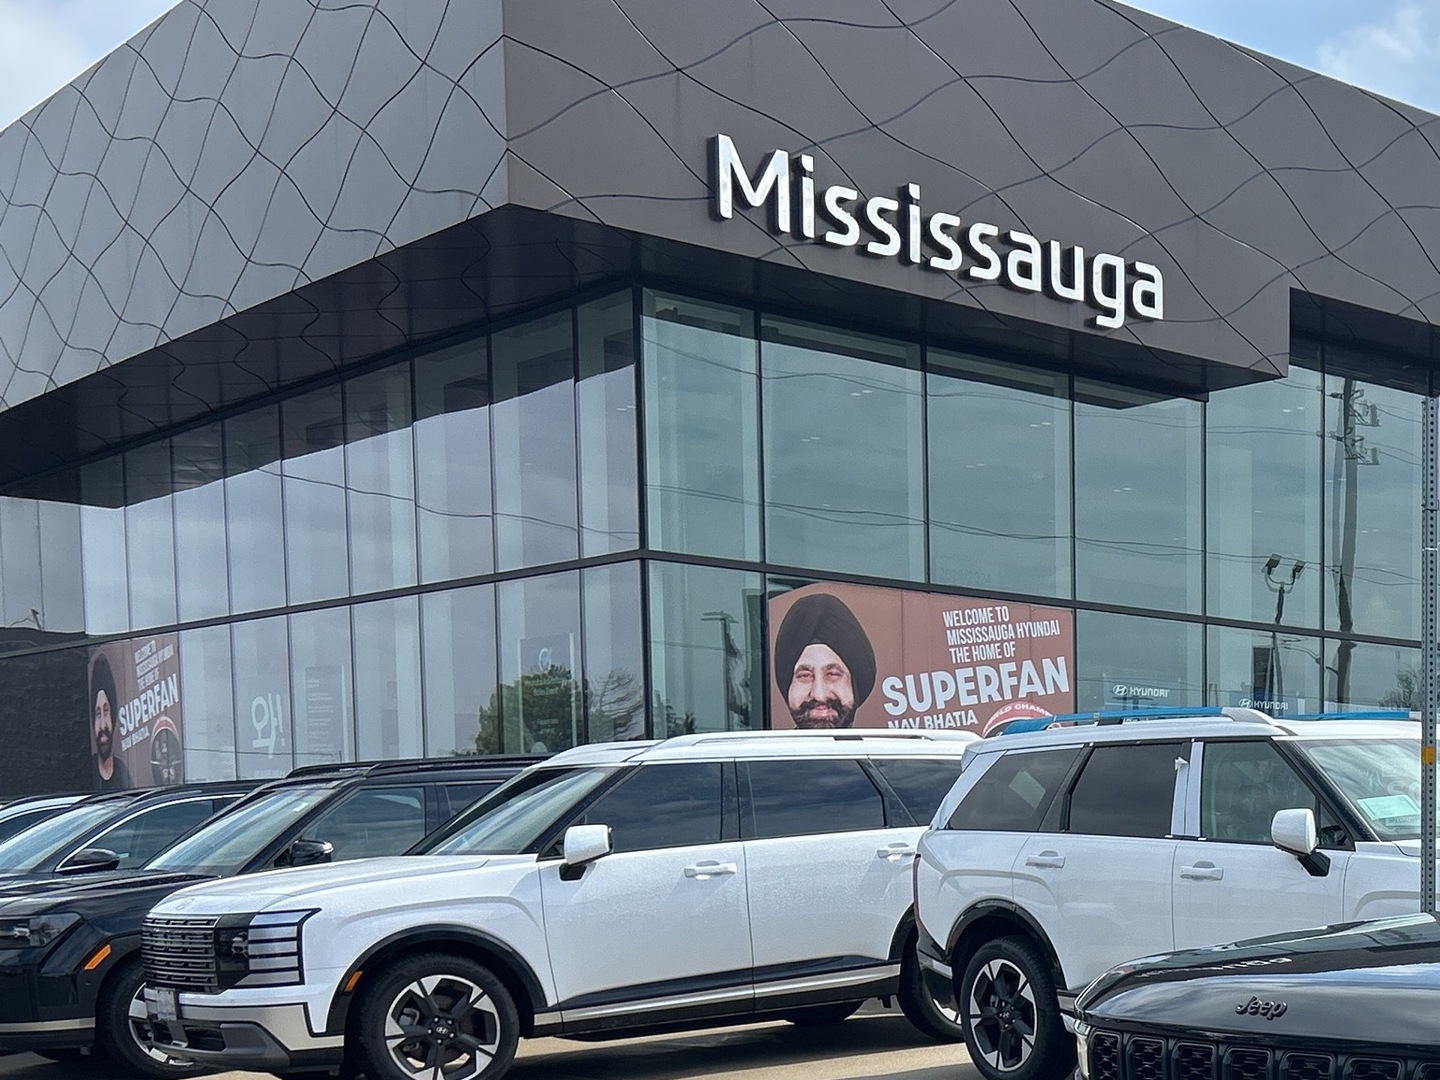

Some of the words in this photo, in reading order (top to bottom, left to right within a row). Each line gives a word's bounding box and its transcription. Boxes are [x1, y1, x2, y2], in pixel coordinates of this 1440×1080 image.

[715, 133, 1164, 329] Mississauga
[943, 606, 995, 628] WELCOME
[995, 605, 1010, 622] TO
[946, 623, 1015, 646] MISSISSAUGA
[1016, 619, 1061, 639] HYUNDAI
[949, 646, 971, 664] THE
[971, 642, 1002, 662] HOME
[1003, 641, 1017, 659] OF
[881, 656, 1070, 716] SUPERFAN
[1129, 687, 1170, 698] HYUNDAI
[119, 673, 179, 736] SUPERFAN
[1252, 701, 1289, 711] HYUNDAI
[923, 709, 979, 730] BHATIA
[1235, 995, 1288, 1020] Jeep
